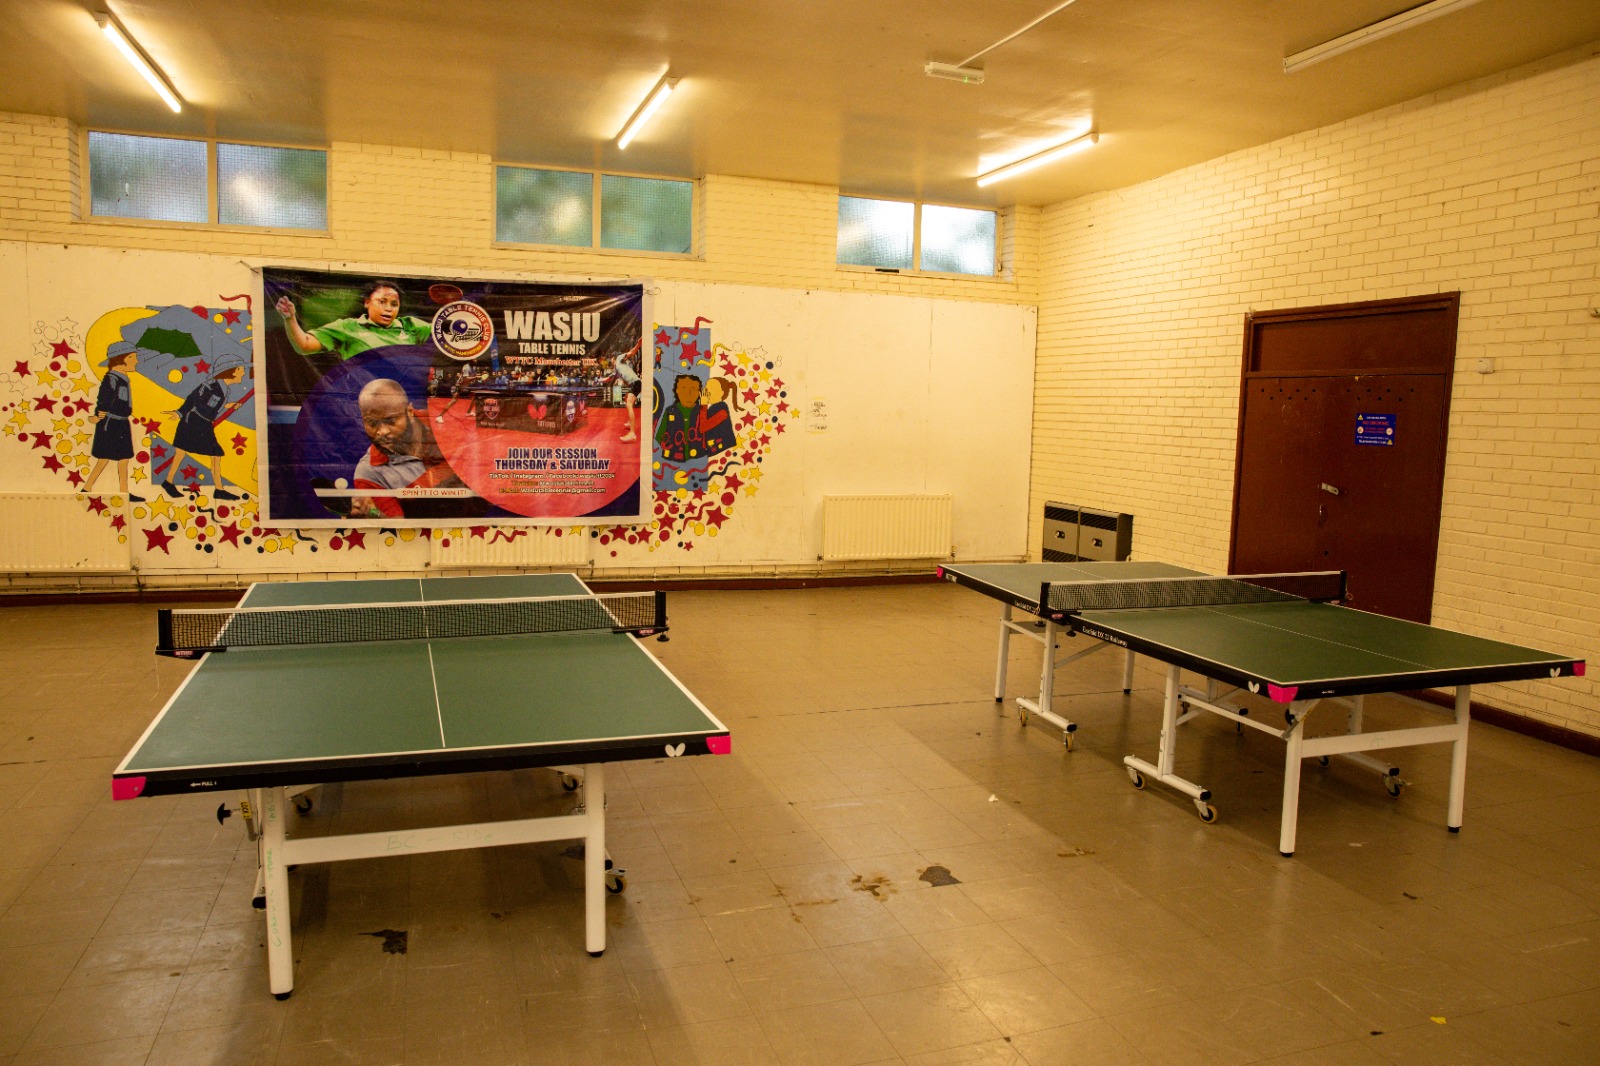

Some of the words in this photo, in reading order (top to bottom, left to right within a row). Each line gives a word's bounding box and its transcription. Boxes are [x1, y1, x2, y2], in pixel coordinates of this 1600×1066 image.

[435, 318, 444, 340] WASIU
[441, 305, 462, 318] TABLE
[464, 305, 486, 322] TENNIS
[503, 309, 600, 343] WASIU
[518, 342, 549, 355] TABLE
[550, 343, 586, 356] TENNIS
[504, 356, 534, 366] WTTC
[534, 356, 582, 366] Manchester
[508, 448, 530, 460] JOIN
[532, 448, 552, 459] OUR
[555, 448, 597, 459] SESSION
[495, 459, 548, 470] THURSDAY
[550, 461, 558, 470] &
[559, 459, 610, 470] SATURDAY
[241, 802, 250, 814] LOCK
